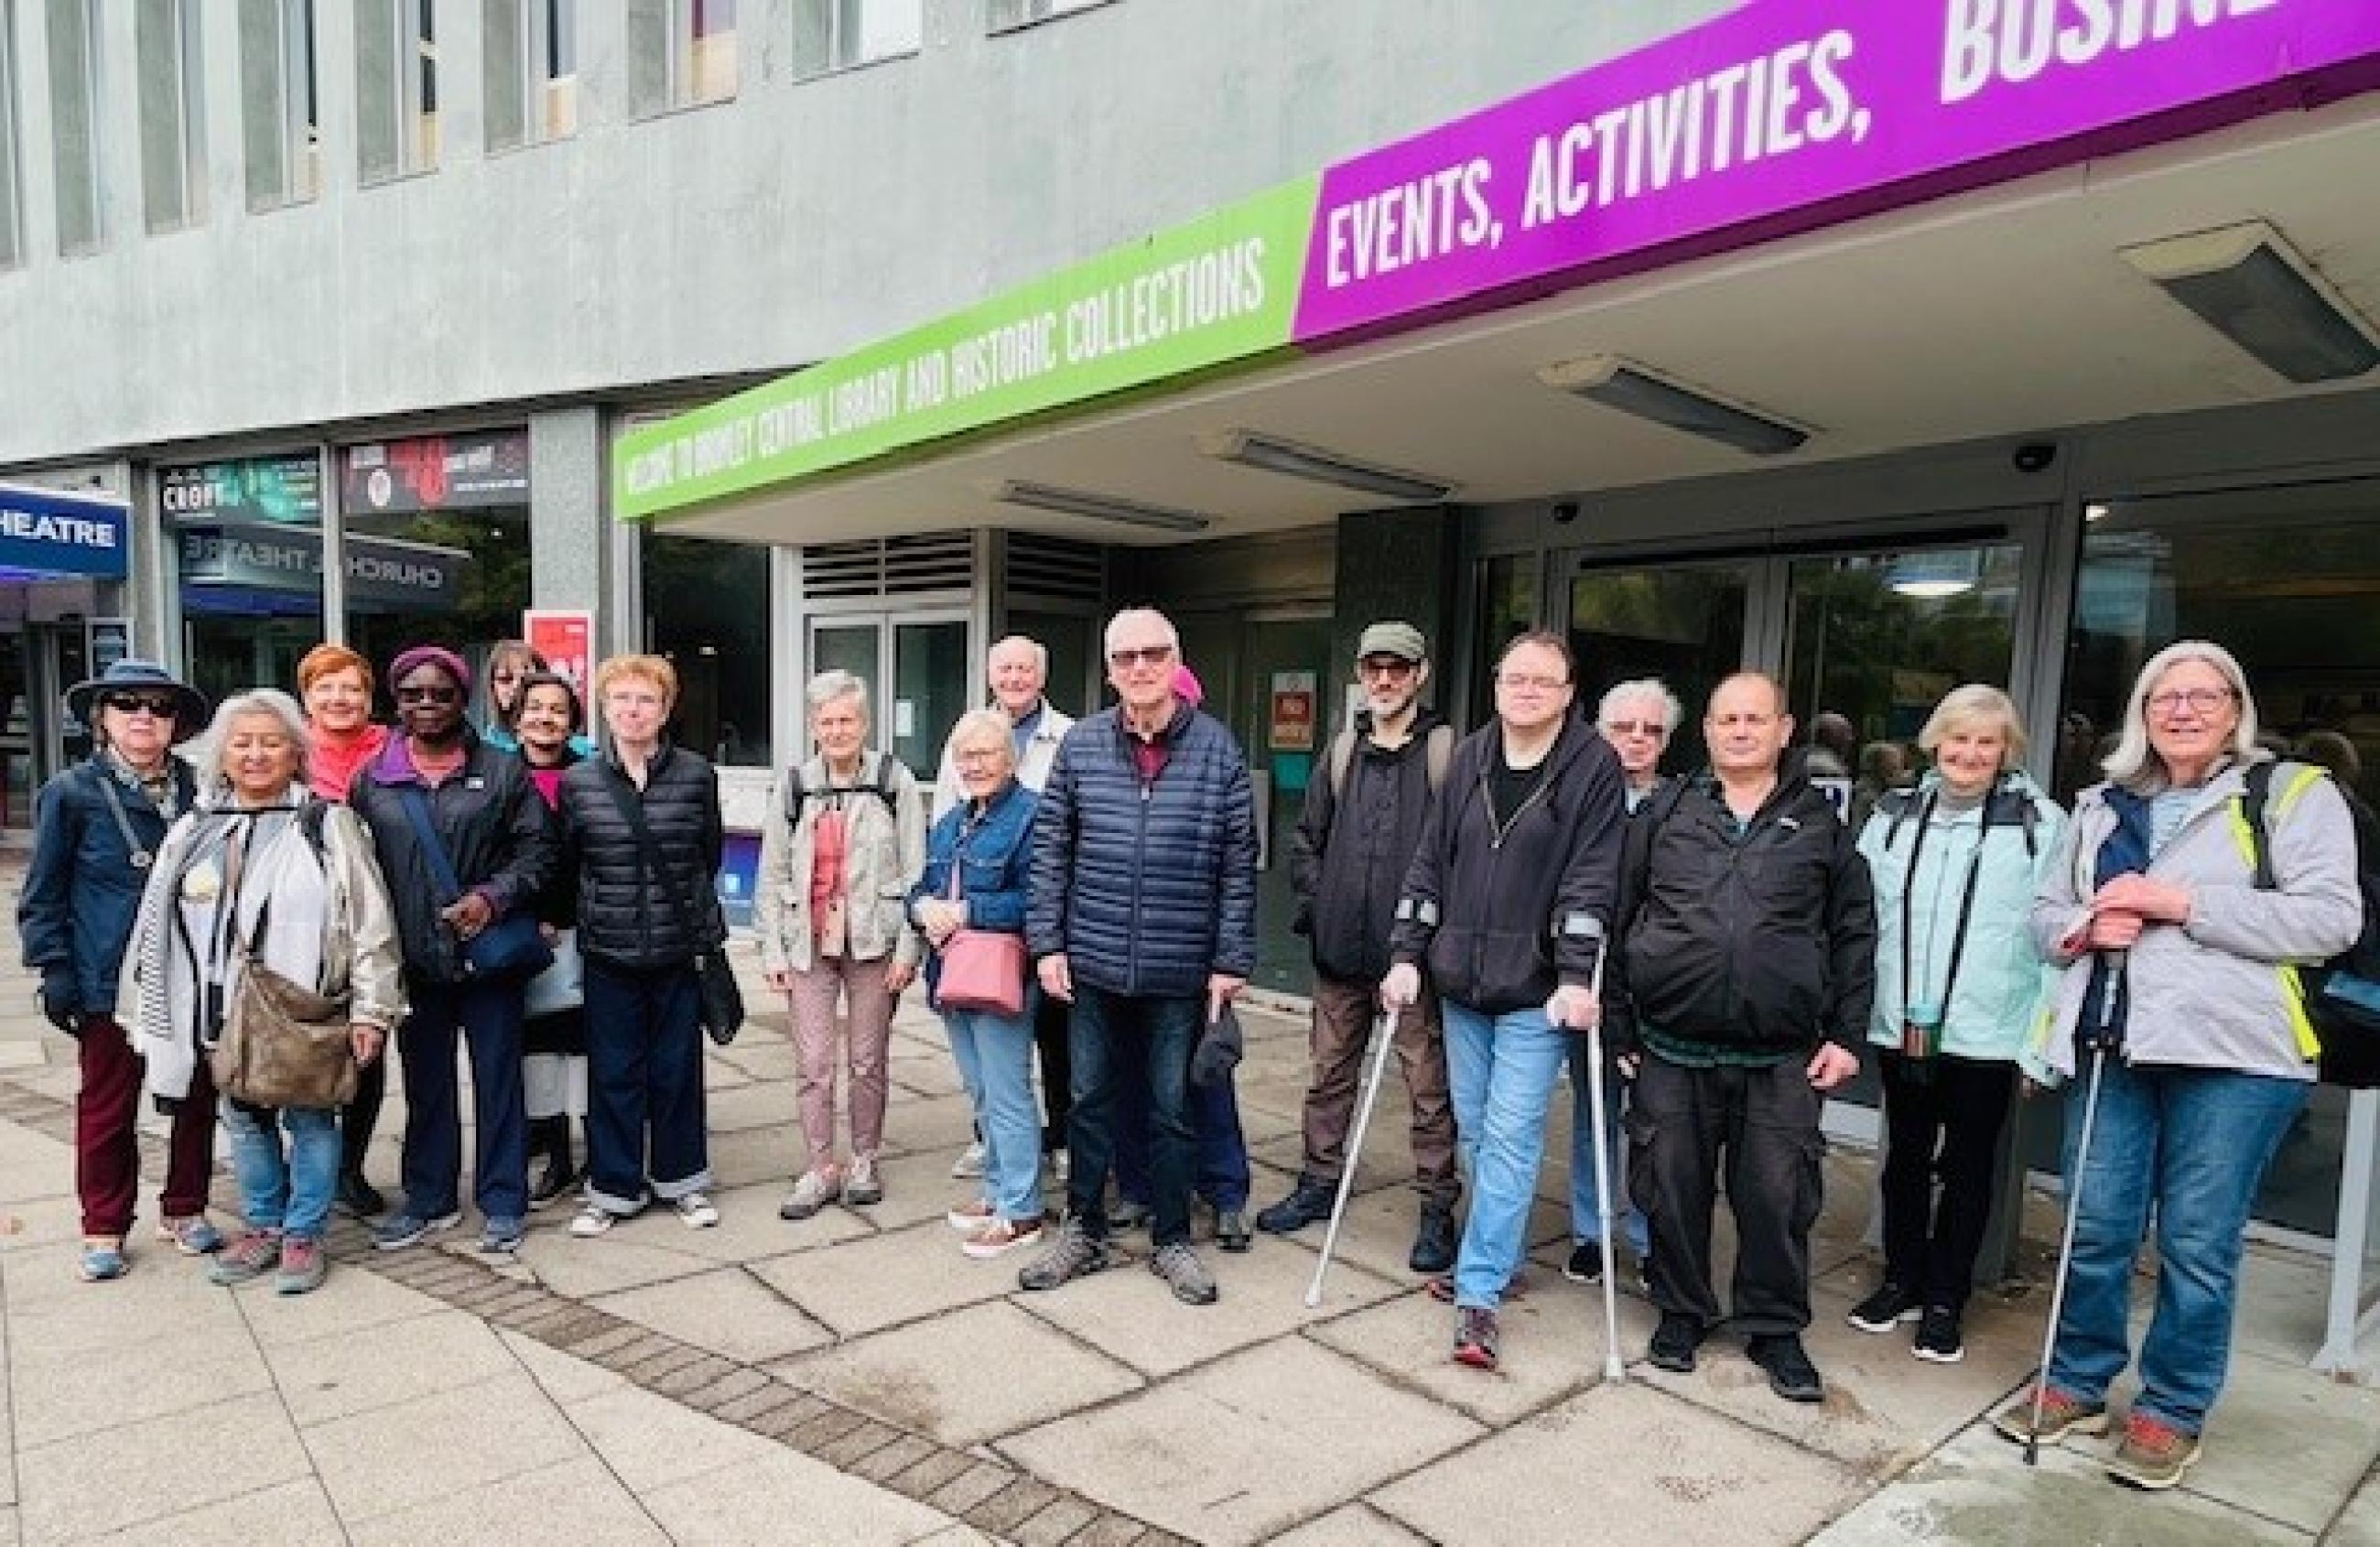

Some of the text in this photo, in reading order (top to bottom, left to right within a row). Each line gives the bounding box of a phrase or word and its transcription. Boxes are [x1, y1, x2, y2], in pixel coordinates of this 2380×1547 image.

[1326, 157, 1503, 289] EVENTS,
[1520, 29, 1871, 230] ACTIVITIES,
[828, 364, 899, 437] LIBRARY
[906, 349, 947, 413] AND
[951, 311, 1057, 399] HISTORIC
[1066, 236, 1263, 364] COLLECTIONS
